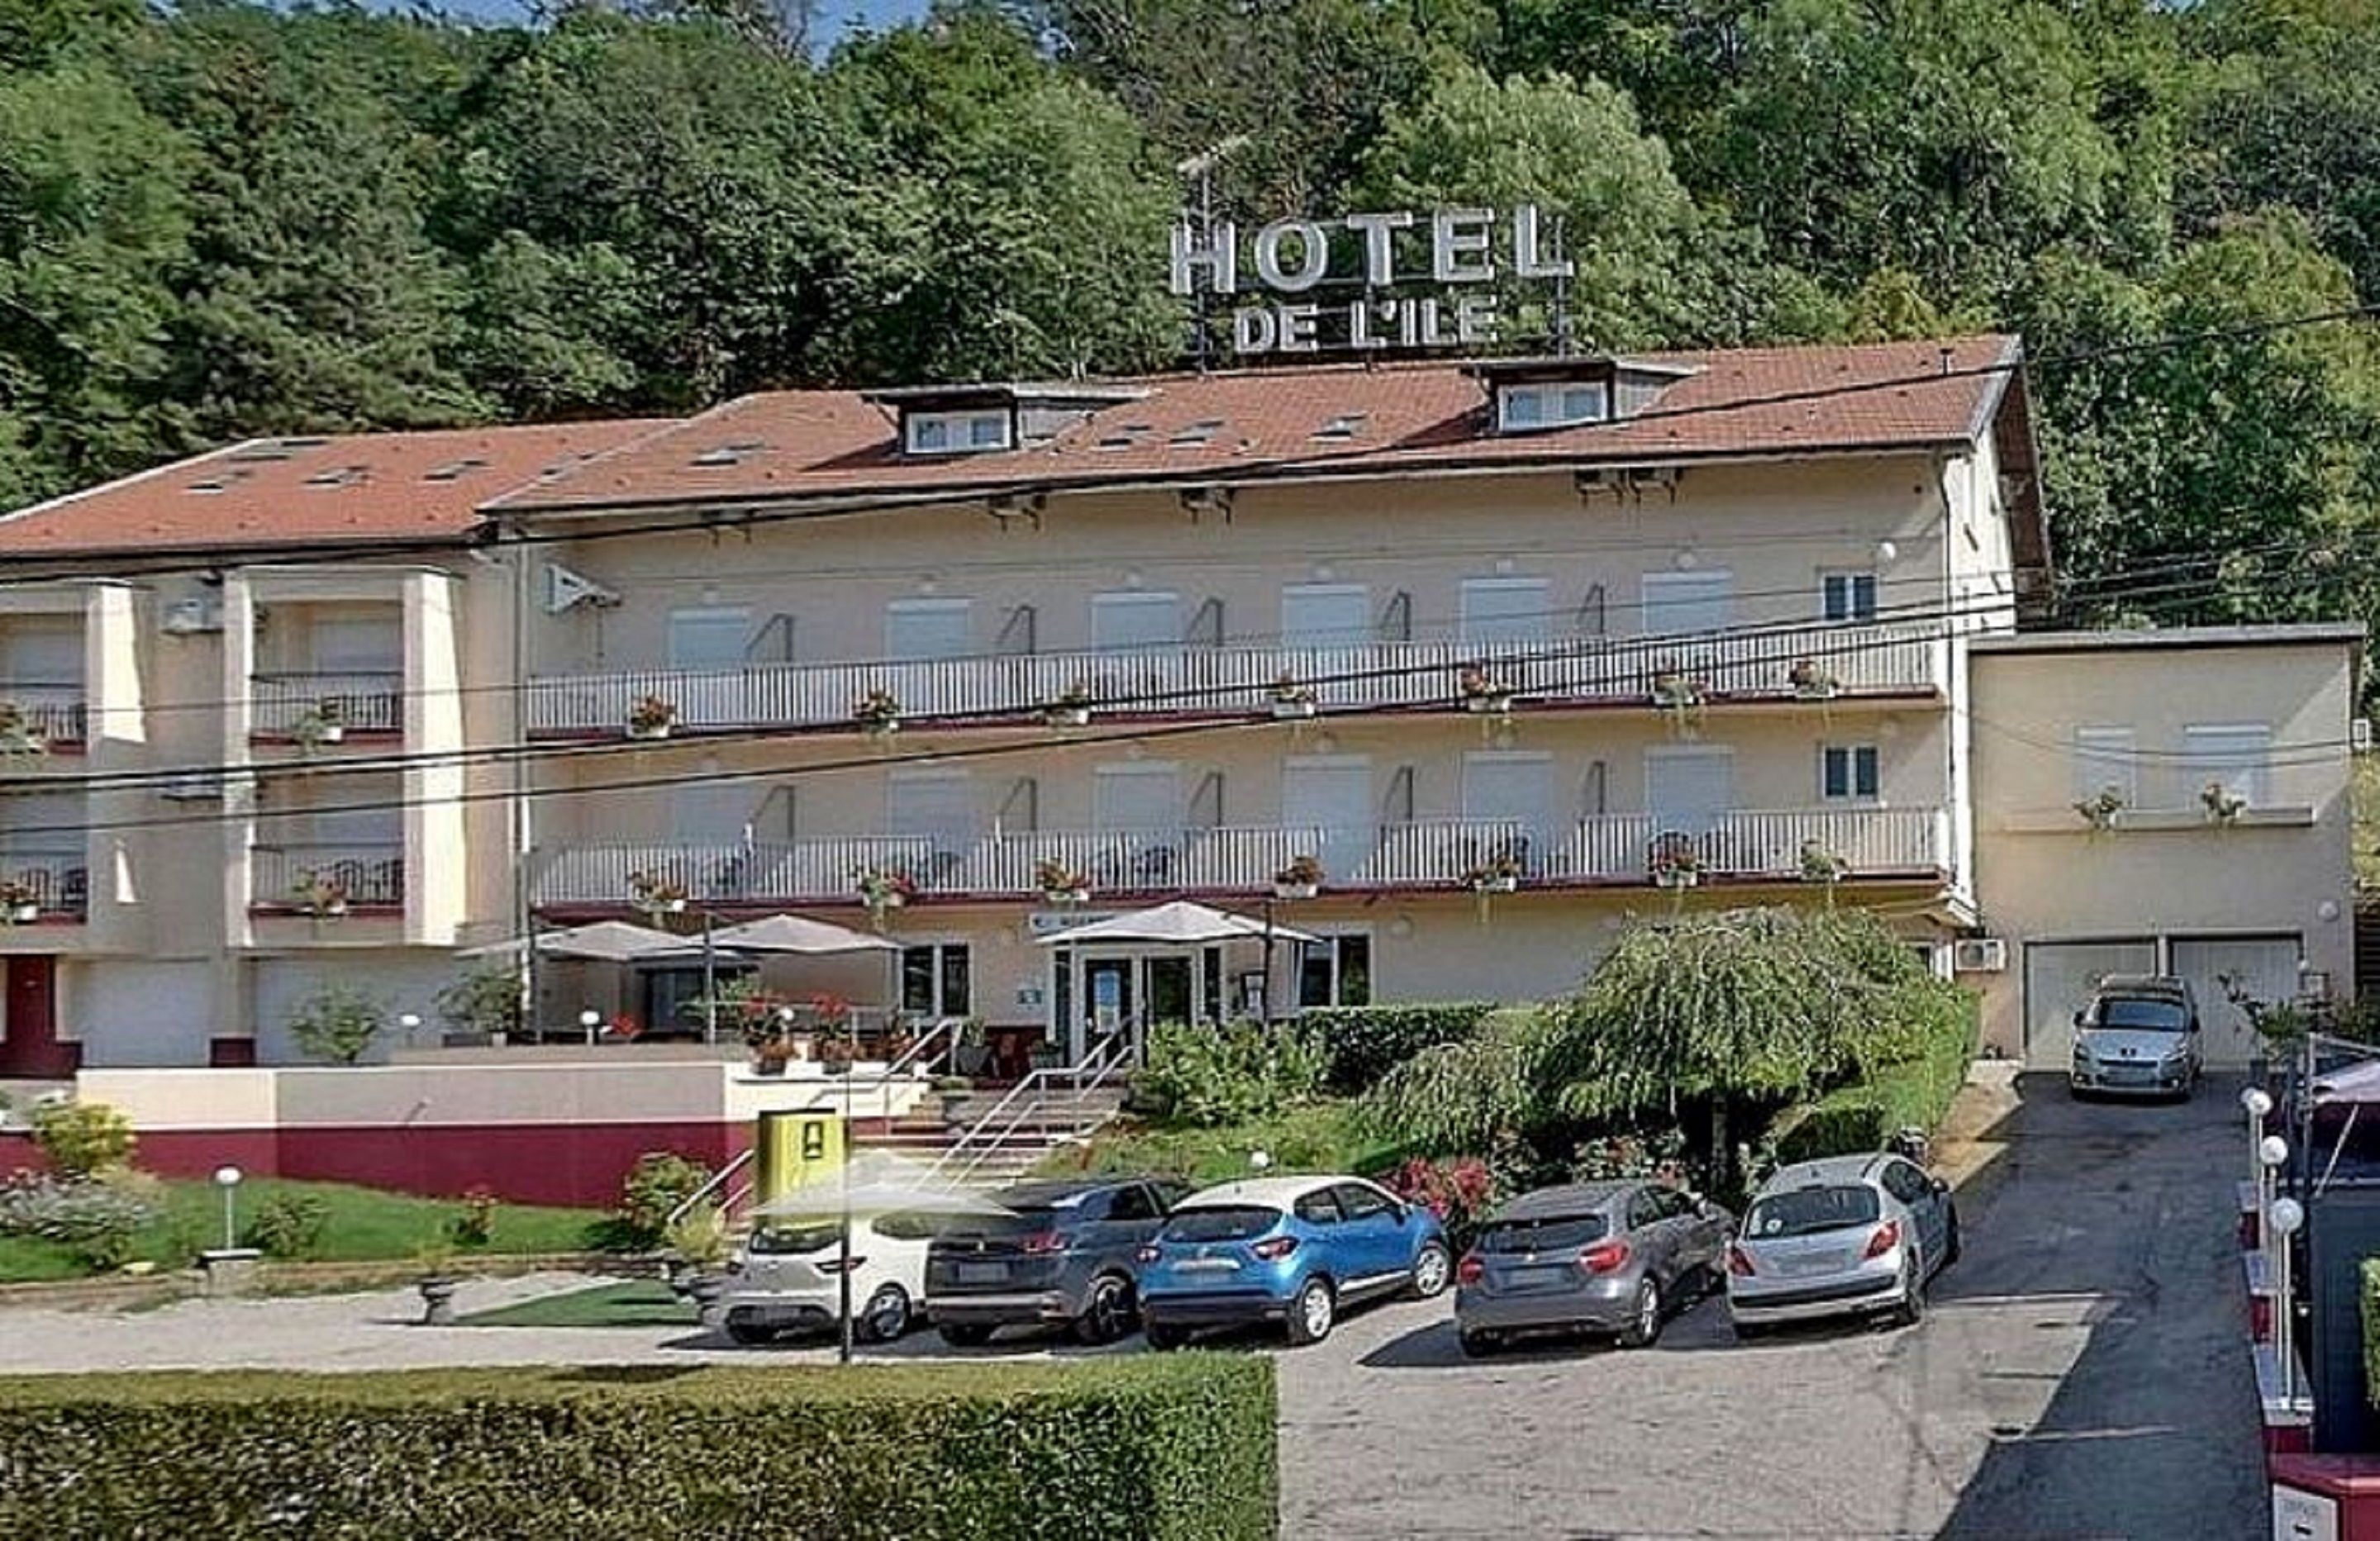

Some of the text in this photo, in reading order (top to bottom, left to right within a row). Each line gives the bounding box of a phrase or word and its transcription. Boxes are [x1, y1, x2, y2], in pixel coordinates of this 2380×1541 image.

[1170, 204, 1573, 293] HOTEL
[1235, 294, 1497, 353] DE L'ILE
